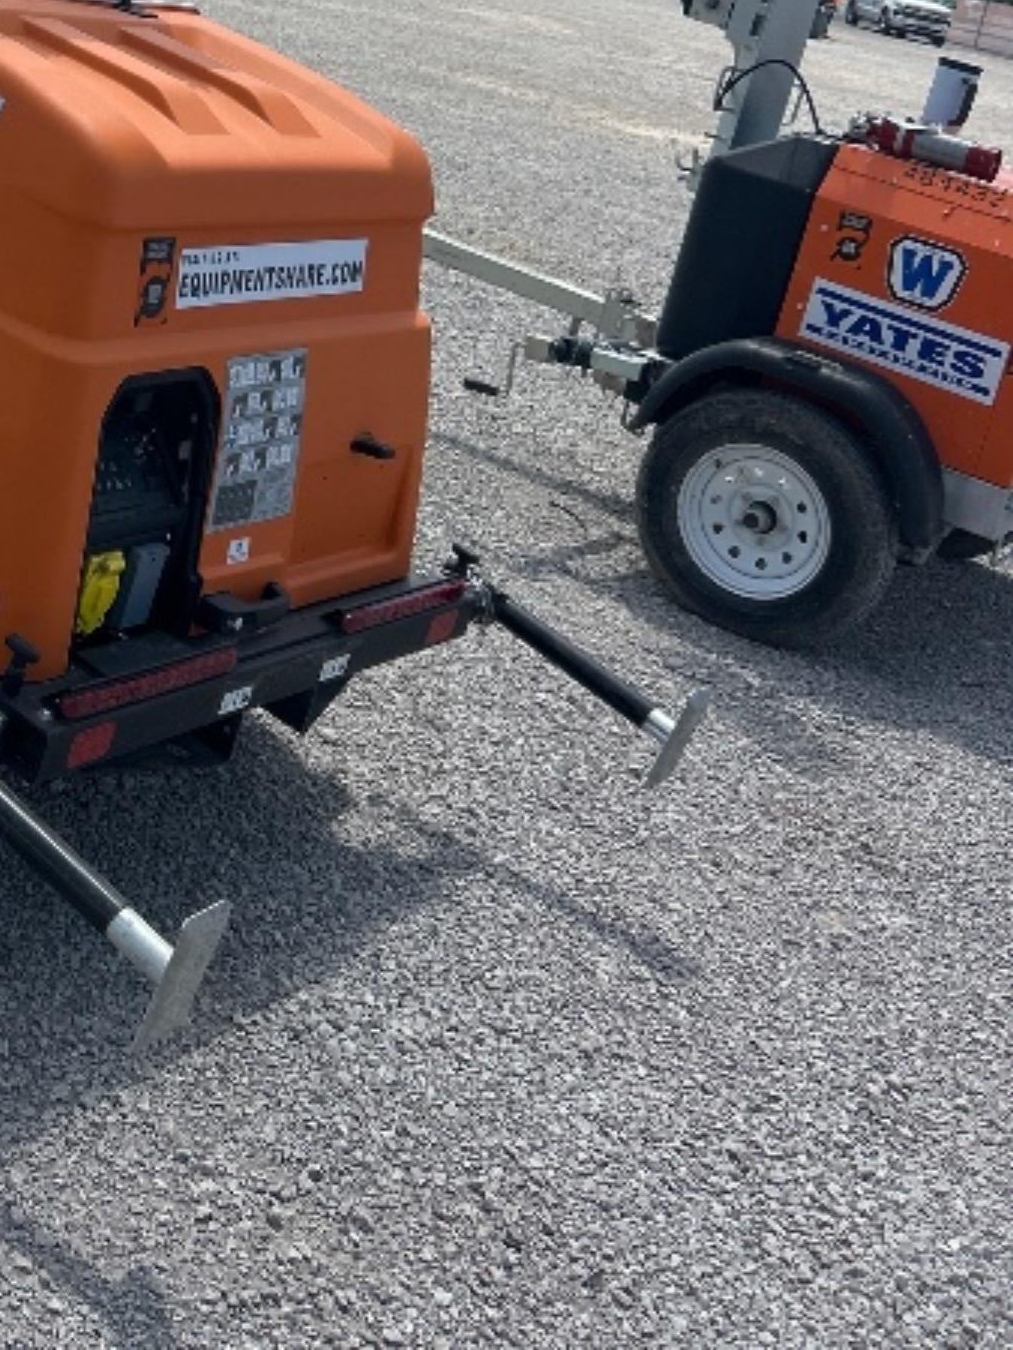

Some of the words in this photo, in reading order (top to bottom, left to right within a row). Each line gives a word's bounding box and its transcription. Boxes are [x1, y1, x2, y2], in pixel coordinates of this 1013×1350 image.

[178, 260, 364, 299] EQUIPMENTSHARE.COM
[900, 245, 954, 300] W
[820, 299, 988, 379] YATES
